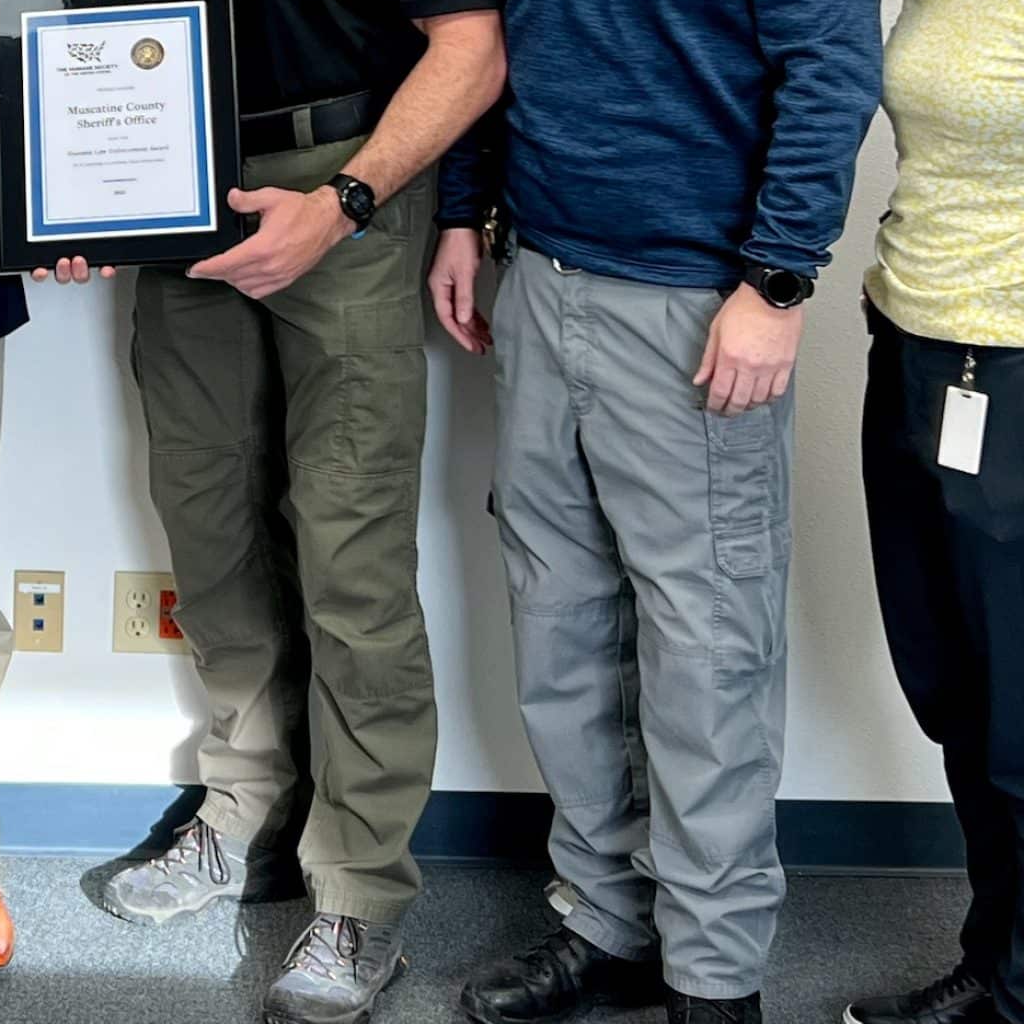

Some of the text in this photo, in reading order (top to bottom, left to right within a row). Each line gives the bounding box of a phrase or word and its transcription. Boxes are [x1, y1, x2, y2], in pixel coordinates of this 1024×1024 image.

[66, 101, 166, 115] Muscatine County
[77, 114, 158, 129] Sheriff's Office
